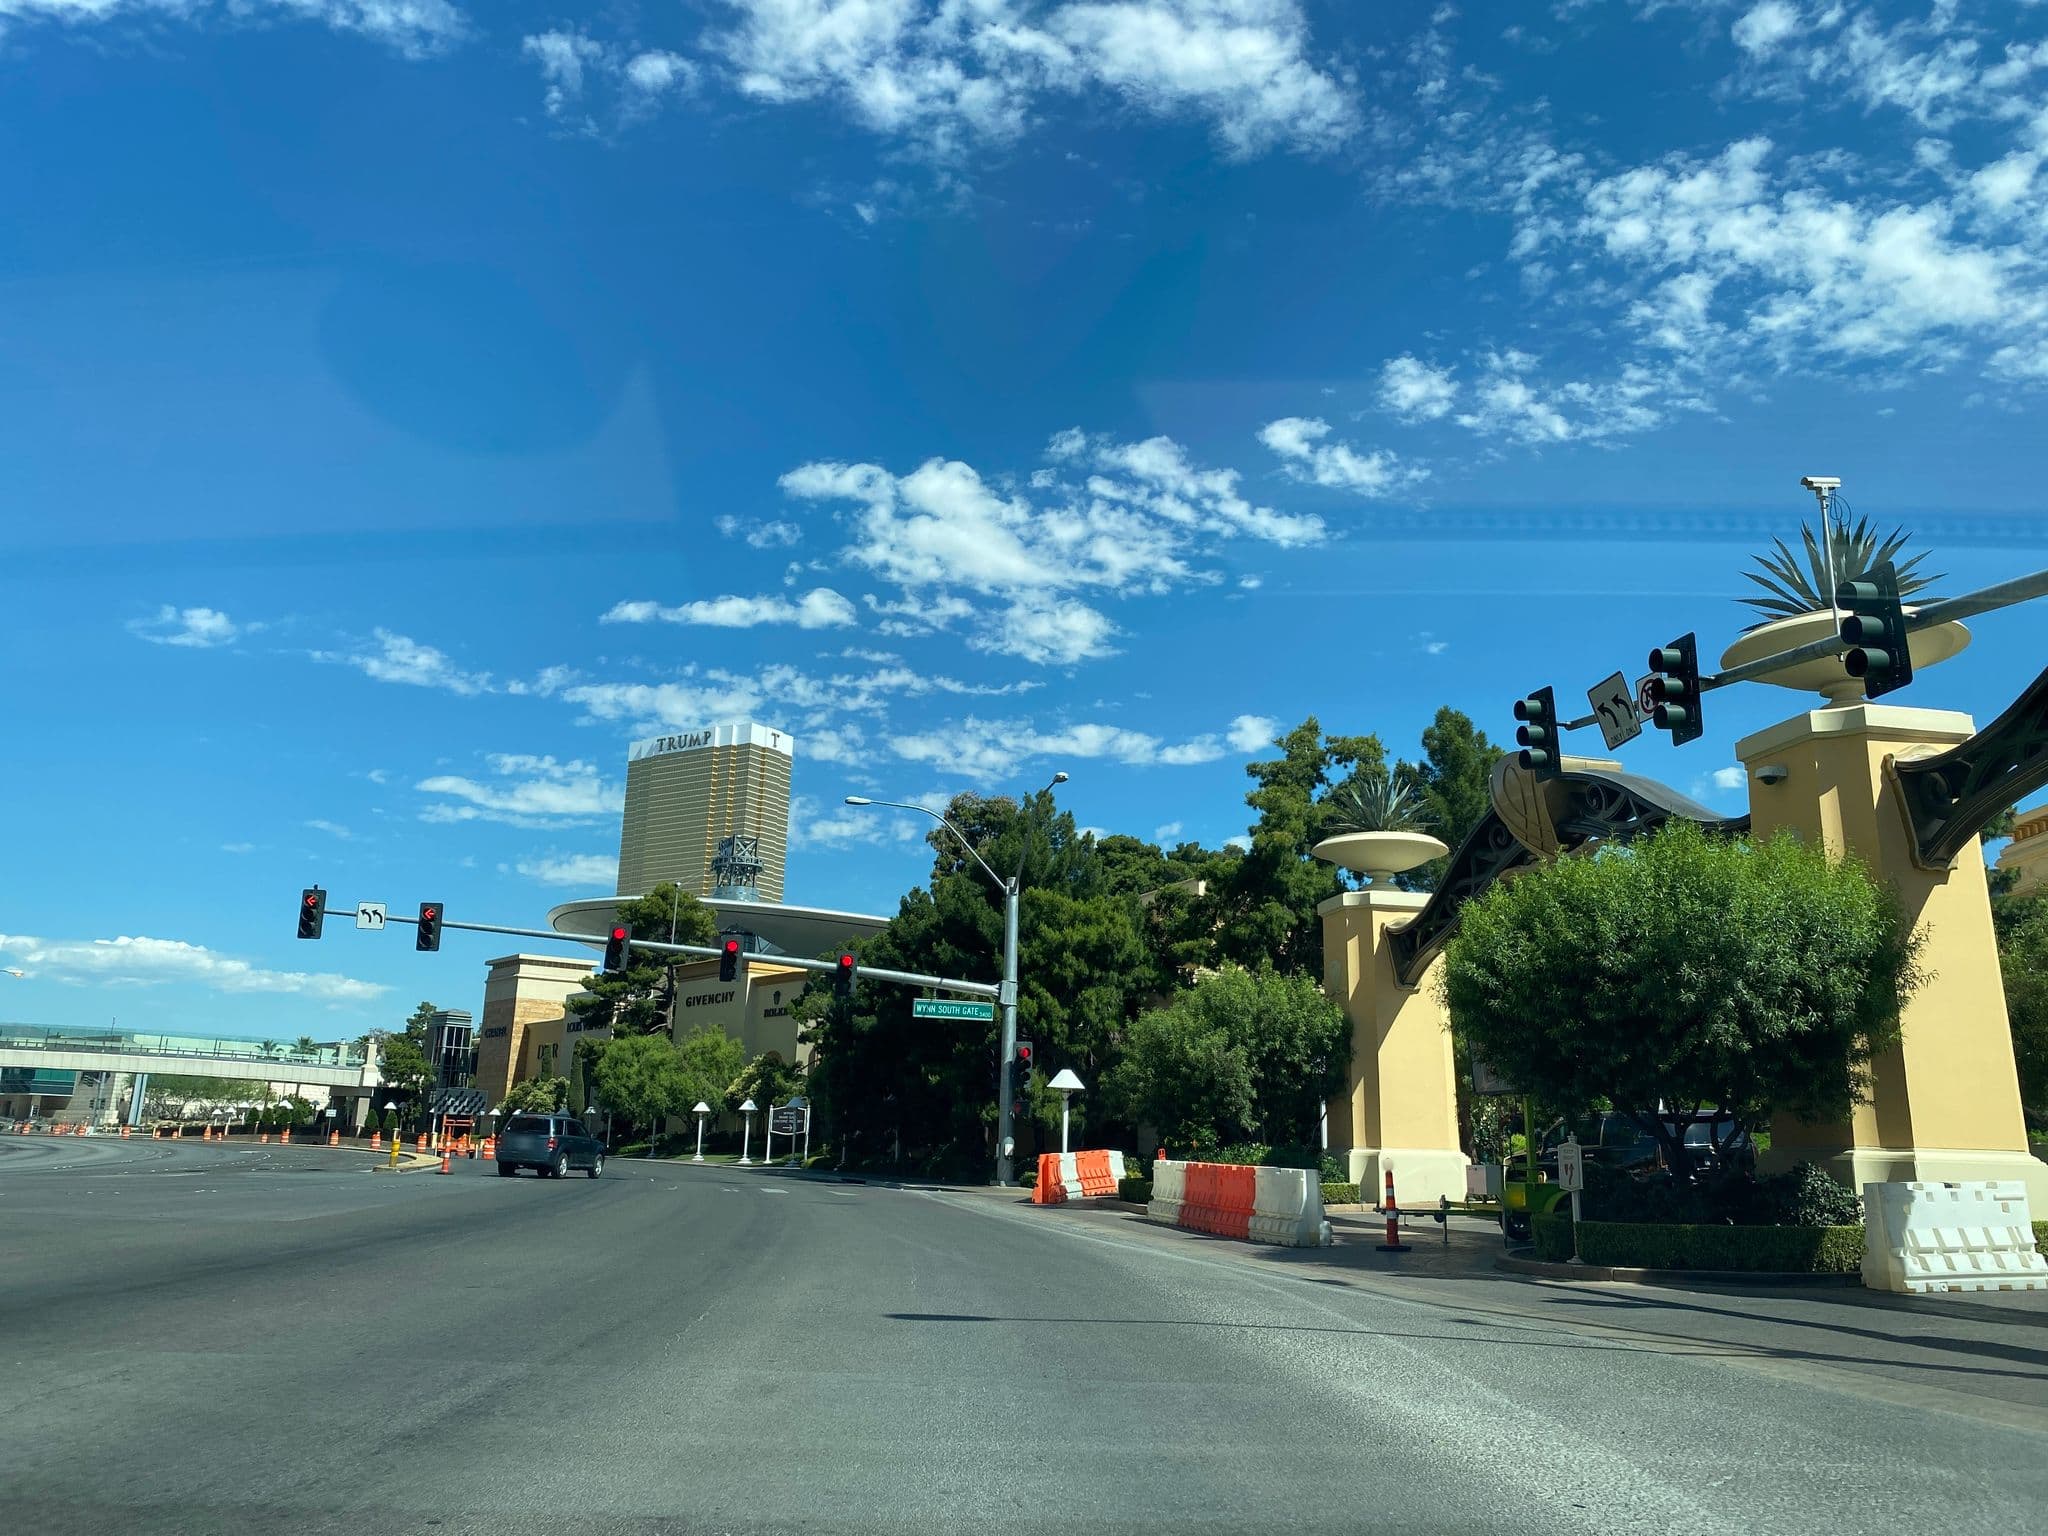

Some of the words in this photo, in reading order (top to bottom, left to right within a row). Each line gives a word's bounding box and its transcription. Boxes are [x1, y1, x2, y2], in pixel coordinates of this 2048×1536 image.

[656, 731, 711, 752] TRUMP
[771, 732, 780, 748] T
[685, 991, 735, 1007] GIVENCHY
[916, 1004, 936, 1013] WYNN
[937, 1005, 960, 1014] SOUTH
[962, 1006, 979, 1016] GATE
